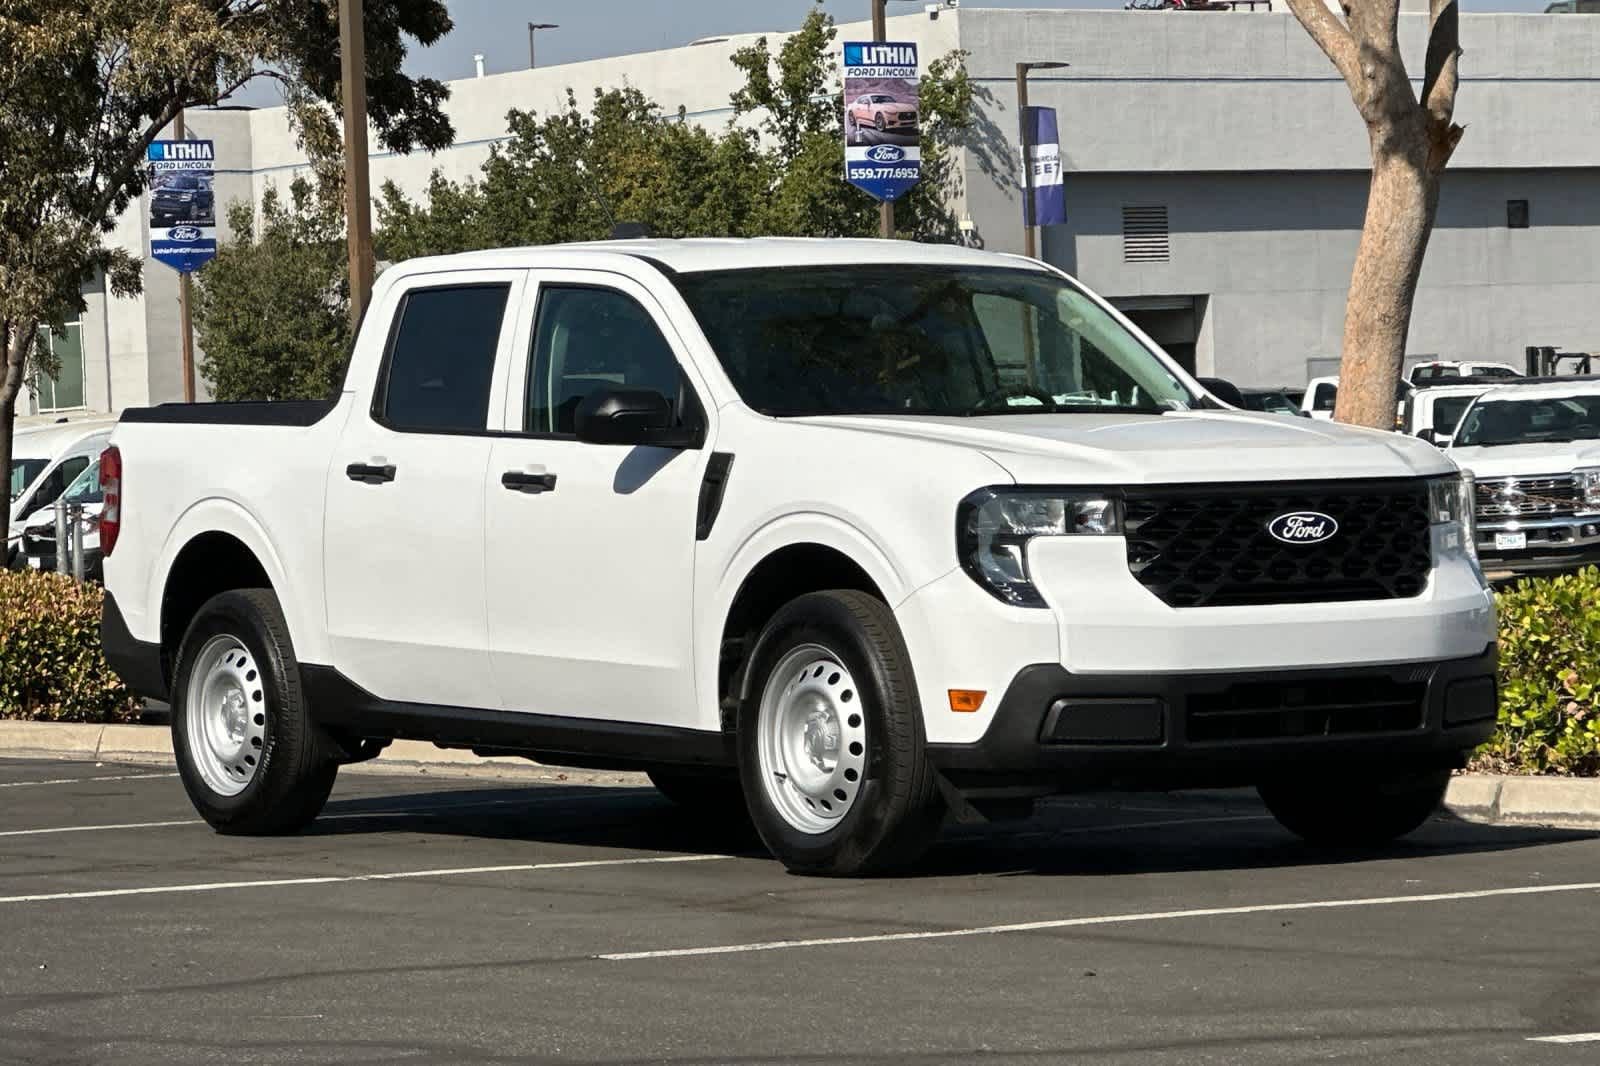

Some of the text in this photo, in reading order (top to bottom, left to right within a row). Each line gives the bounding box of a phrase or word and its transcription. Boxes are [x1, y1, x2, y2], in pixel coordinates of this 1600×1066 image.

[862, 46, 916, 64] LITHIA
[847, 68, 916, 76] FORD LINCOLN
[163, 143, 212, 159] LITHIA
[874, 146, 900, 160] Ford
[177, 161, 212, 169] LINCOLN
[850, 167, 919, 179] 559.777.6952
[174, 228, 197, 239] Ford
[1283, 516, 1325, 538] Ford
